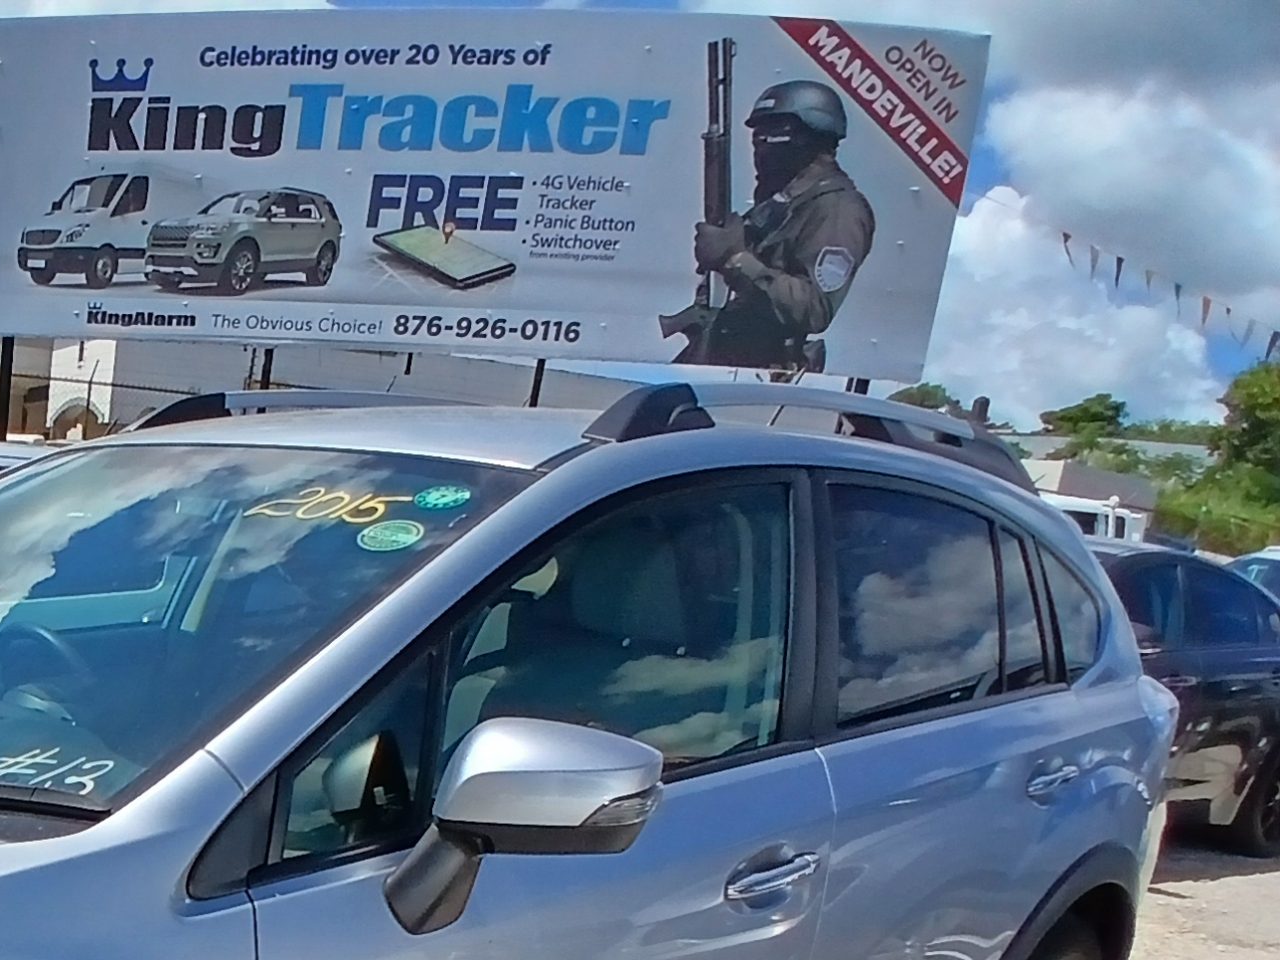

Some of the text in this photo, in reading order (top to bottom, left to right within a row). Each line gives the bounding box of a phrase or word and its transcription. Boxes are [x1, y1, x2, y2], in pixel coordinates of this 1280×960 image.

[199, 44, 553, 70] Celebrating over 20 Years of
[914, 38, 967, 90] NOW
[884, 45, 960, 124] OPEN IN
[808, 25, 963, 184] MANDEVILLE!
[540, 175, 624, 192] 4G Vehicle
[366, 174, 524, 231] FREE
[538, 194, 596, 211] Tracker
[533, 213, 636, 232] Panic Button
[530, 233, 620, 250] Switchover
[87, 310, 581, 343] KingAlarm The Obvious Choice! 876-926-0116
[243, 486, 414, 523] 2015
